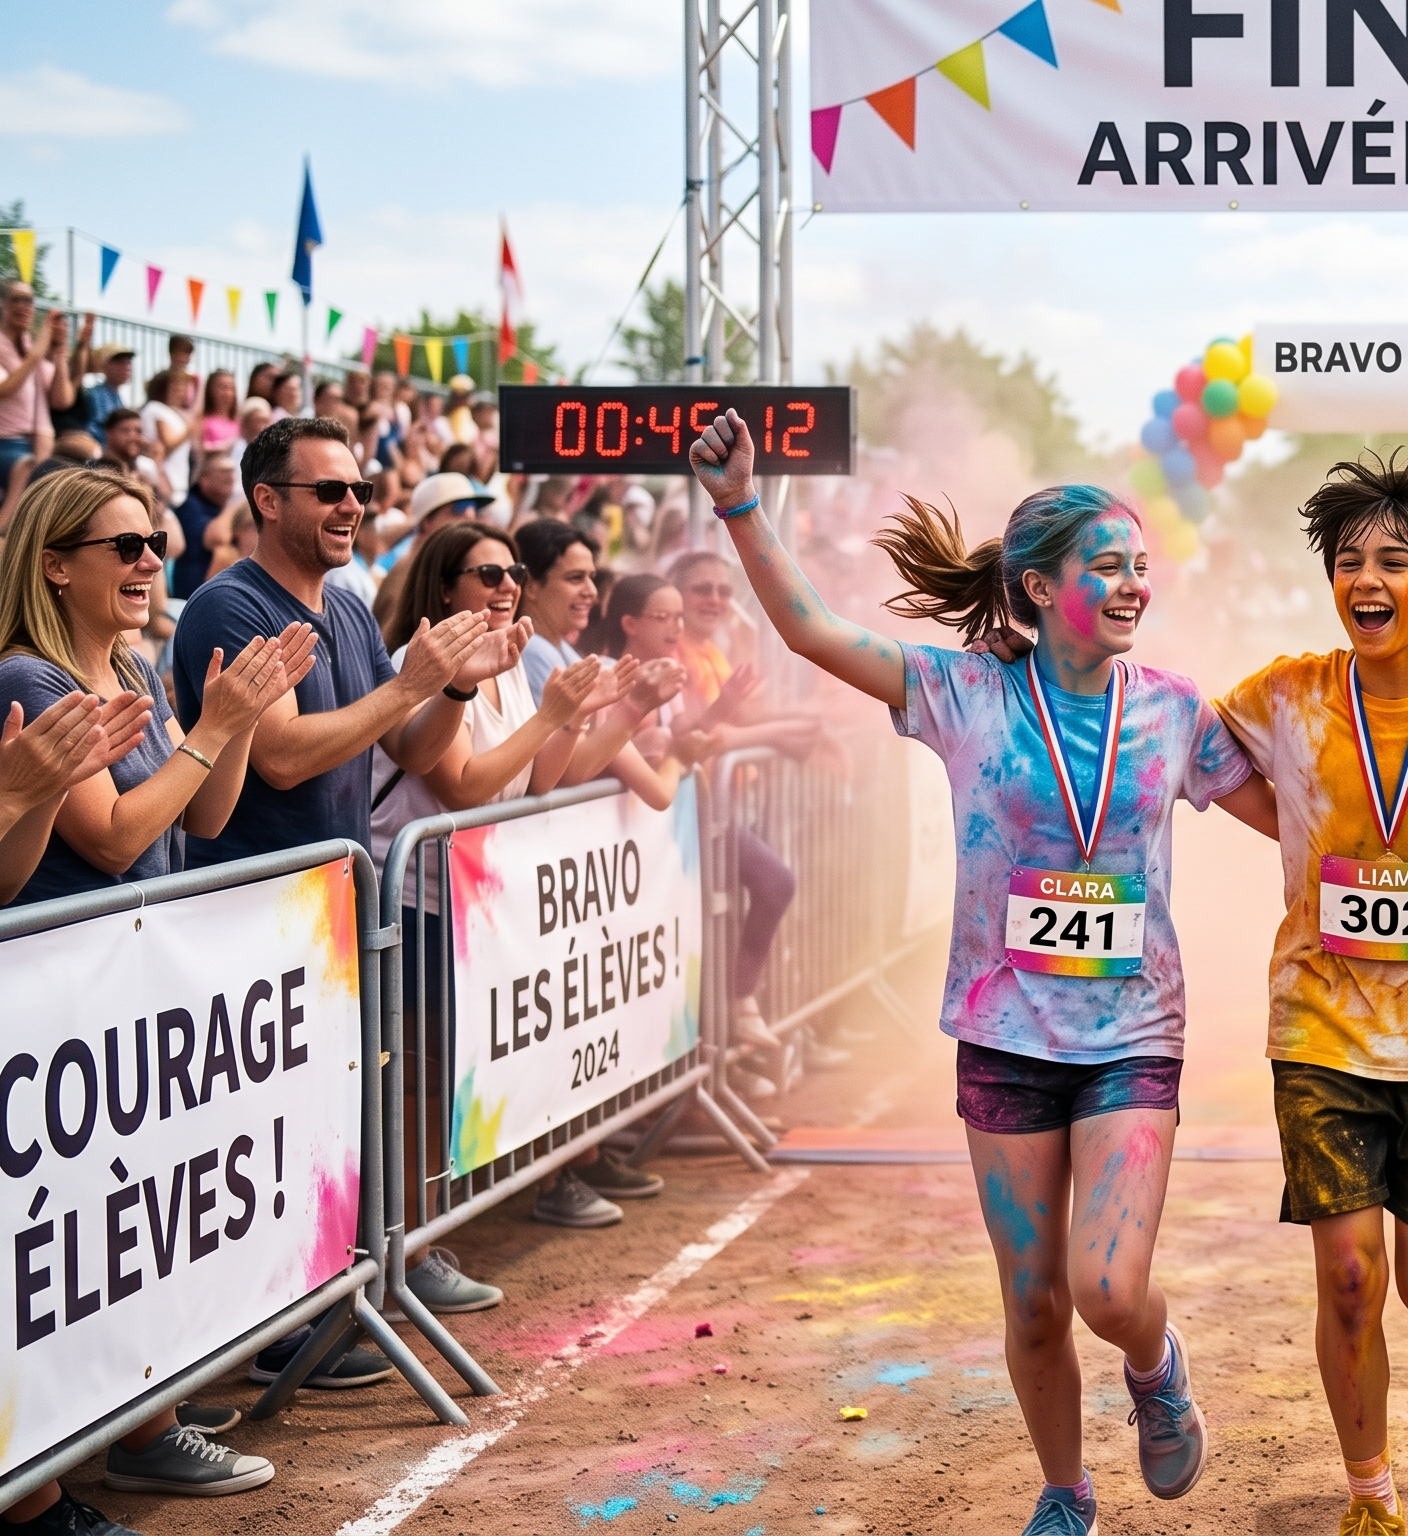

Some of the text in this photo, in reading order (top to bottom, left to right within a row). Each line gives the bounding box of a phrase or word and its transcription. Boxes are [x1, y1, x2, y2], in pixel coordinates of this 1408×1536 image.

[1275, 342, 1402, 374] BRAVO
[537, 839, 640, 937] BRAVO
[1040, 878, 1115, 899] CLARA
[1029, 906, 1114, 951] 241
[490, 968, 552, 1062] LES
[563, 923, 666, 1031] ÉLÈVES
[0, 965, 308, 1179] COURAGE
[571, 1029, 620, 1090] 2024
[15, 1133, 257, 1351] ÉLÈVES
